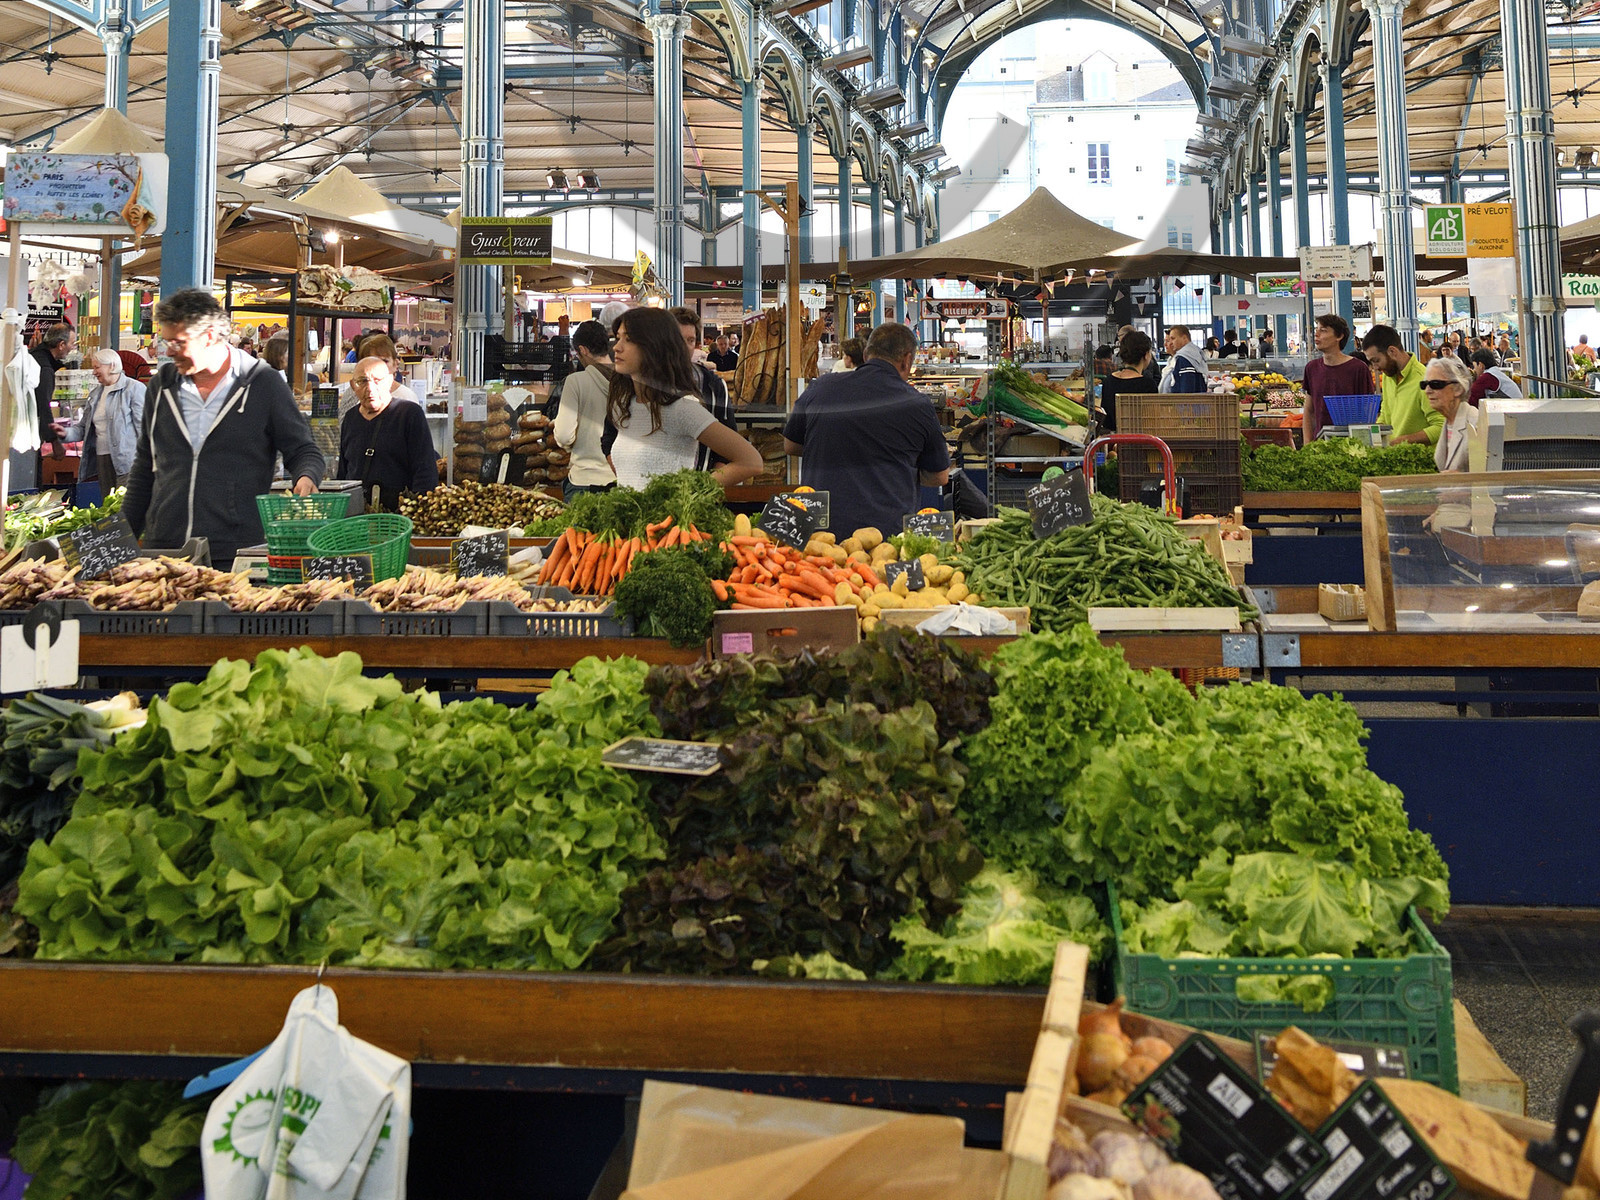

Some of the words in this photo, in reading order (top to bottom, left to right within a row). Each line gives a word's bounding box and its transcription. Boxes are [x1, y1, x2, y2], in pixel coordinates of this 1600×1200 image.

[42, 172, 64, 180] PARIS
[1467, 206, 1481, 215] PRÉ
[1430, 218, 1458, 240] AB
[1213, 1080, 1245, 1112] AIL
